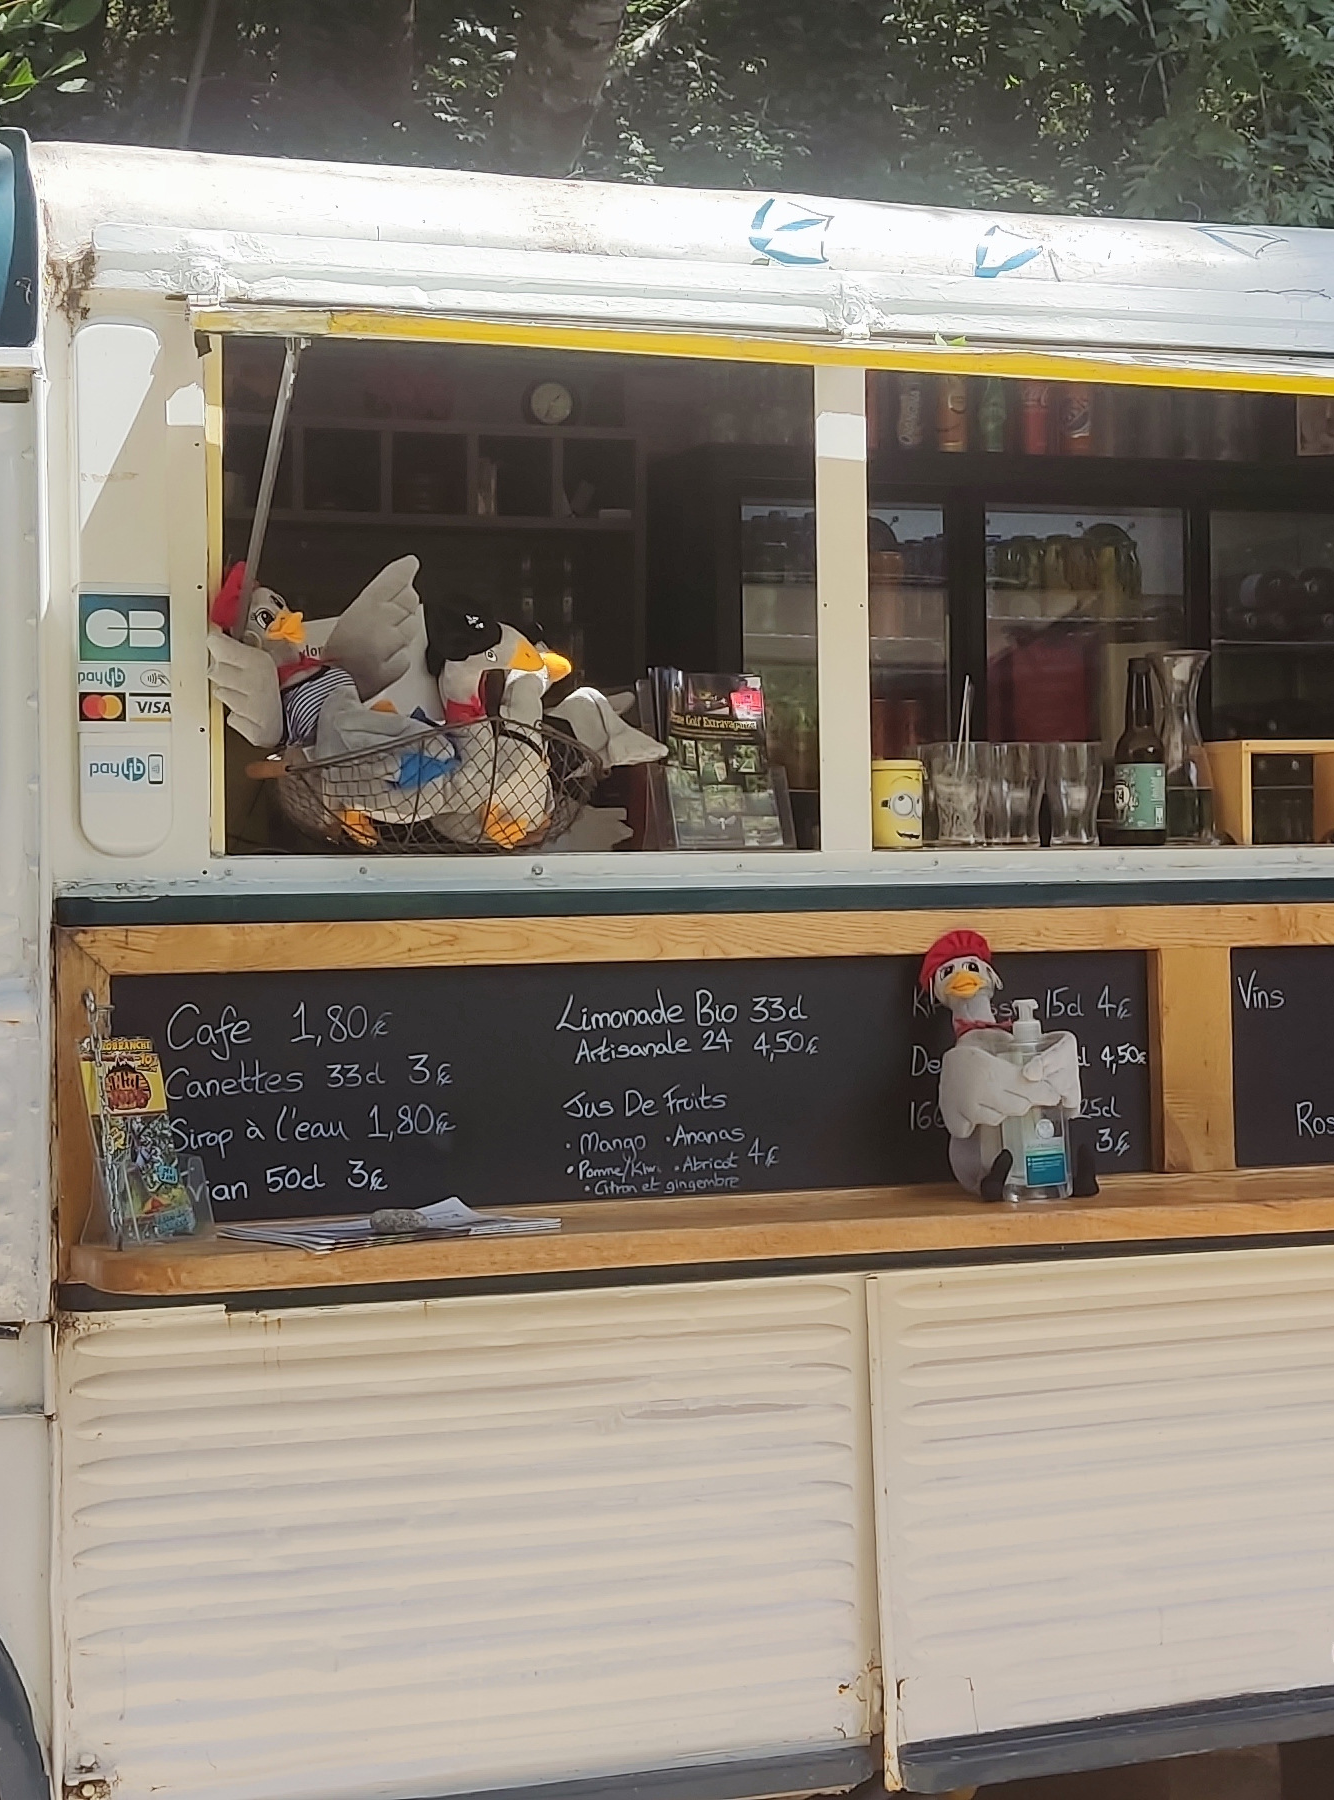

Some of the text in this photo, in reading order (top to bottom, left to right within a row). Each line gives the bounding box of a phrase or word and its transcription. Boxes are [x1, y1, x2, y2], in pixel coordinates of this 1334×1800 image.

[86, 609, 166, 647] CB
[135, 701, 171, 714] VISA
[90, 757, 146, 781] paylib
[1097, 985, 1131, 1019] 4€
[1238, 970, 1284, 1008] Vins
[556, 989, 685, 1030] Limonade
[696, 990, 737, 1026] Bio
[167, 1002, 391, 1060] Cafe 1,80€
[575, 1028, 818, 1064] Artisanale 24 4,50€
[165, 1060, 303, 1097] Canettes
[408, 1054, 452, 1085] 3€
[1100, 1046, 1146, 1074] 4,50€
[563, 1084, 727, 1118] Jus De Fruits
[171, 1104, 456, 1158] Sirop à l'eau 1,80€
[580, 1125, 744, 1160] Mango Ananas
[1096, 1128, 1130, 1156] 3€
[682, 1138, 779, 1172] Abricot 4€
[347, 1159, 388, 1191] 3€
[595, 1173, 739, 1195] Citron et gingembre
